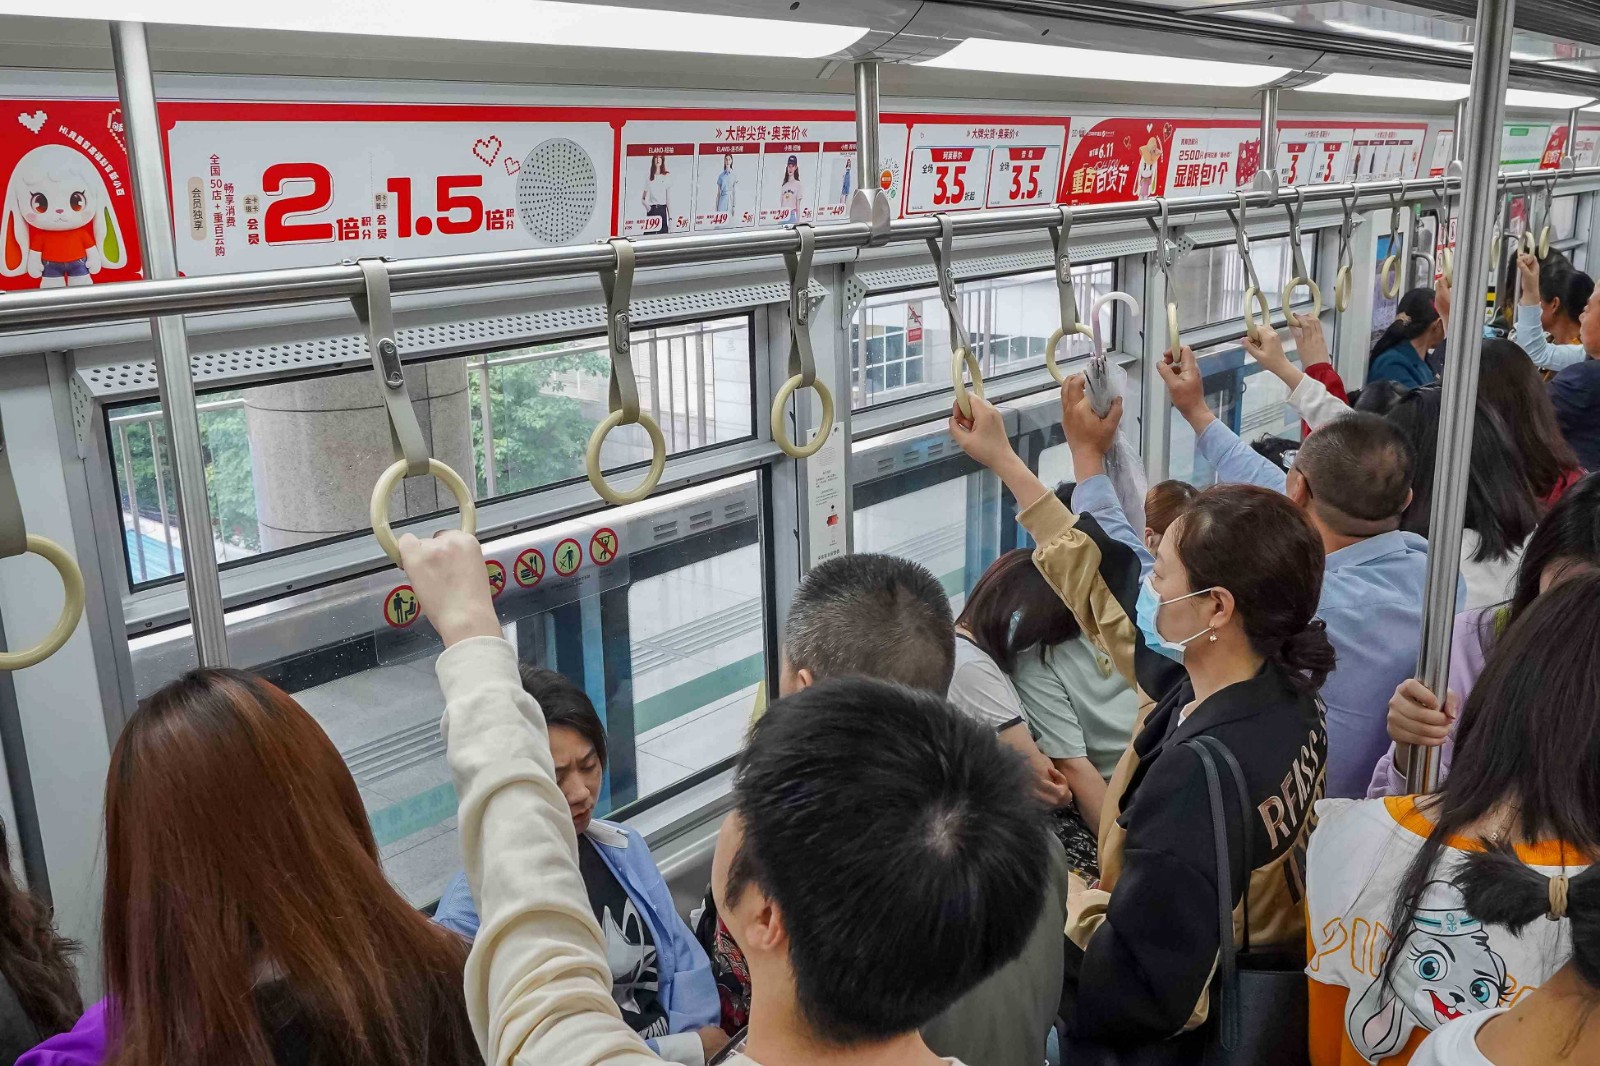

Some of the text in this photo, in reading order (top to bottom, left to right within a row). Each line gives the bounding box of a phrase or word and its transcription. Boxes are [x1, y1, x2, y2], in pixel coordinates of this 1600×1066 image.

[922, 164, 934, 174] 全场
[1000, 161, 1010, 172] 全场
[933, 165, 967, 205] 3.5
[1009, 164, 1041, 201] 3.5
[192, 187, 204, 231] 会员独享
[223, 183, 236, 227] 畅享消费
[262, 162, 335, 246] 2
[386, 174, 484, 239] 1.5
[247, 218, 260, 245] 会员
[336, 217, 360, 241] 倍
[361, 216, 372, 240] 积分
[376, 214, 388, 240] 会员
[485, 209, 505, 231] 倍
[506, 208, 515, 230] 积分
